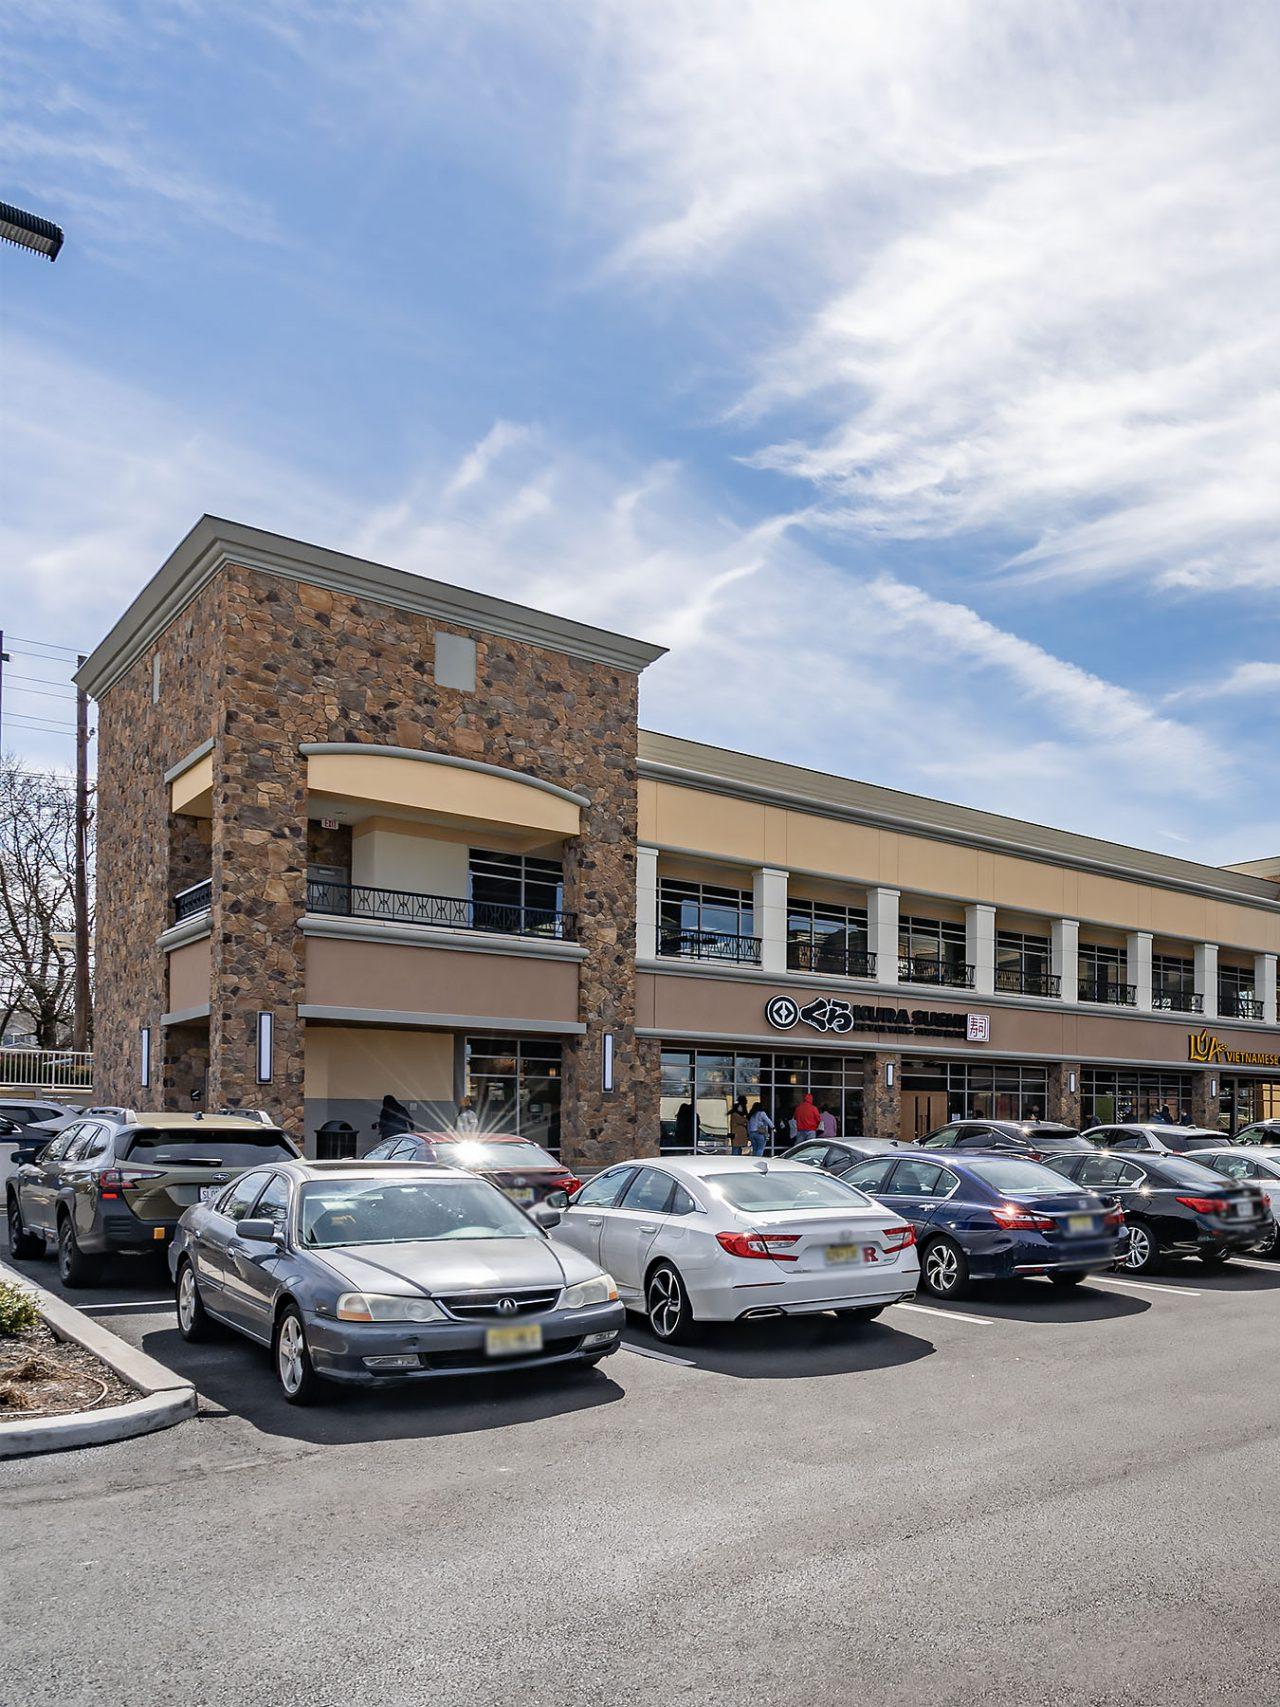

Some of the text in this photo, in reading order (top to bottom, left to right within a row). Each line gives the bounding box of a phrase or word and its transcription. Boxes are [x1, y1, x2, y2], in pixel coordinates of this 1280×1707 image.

[853, 1005, 967, 1028] KURA SUSHI
[1226, 1051, 1279, 1066] VIETNAMESE
[863, 1246, 879, 1262] R
